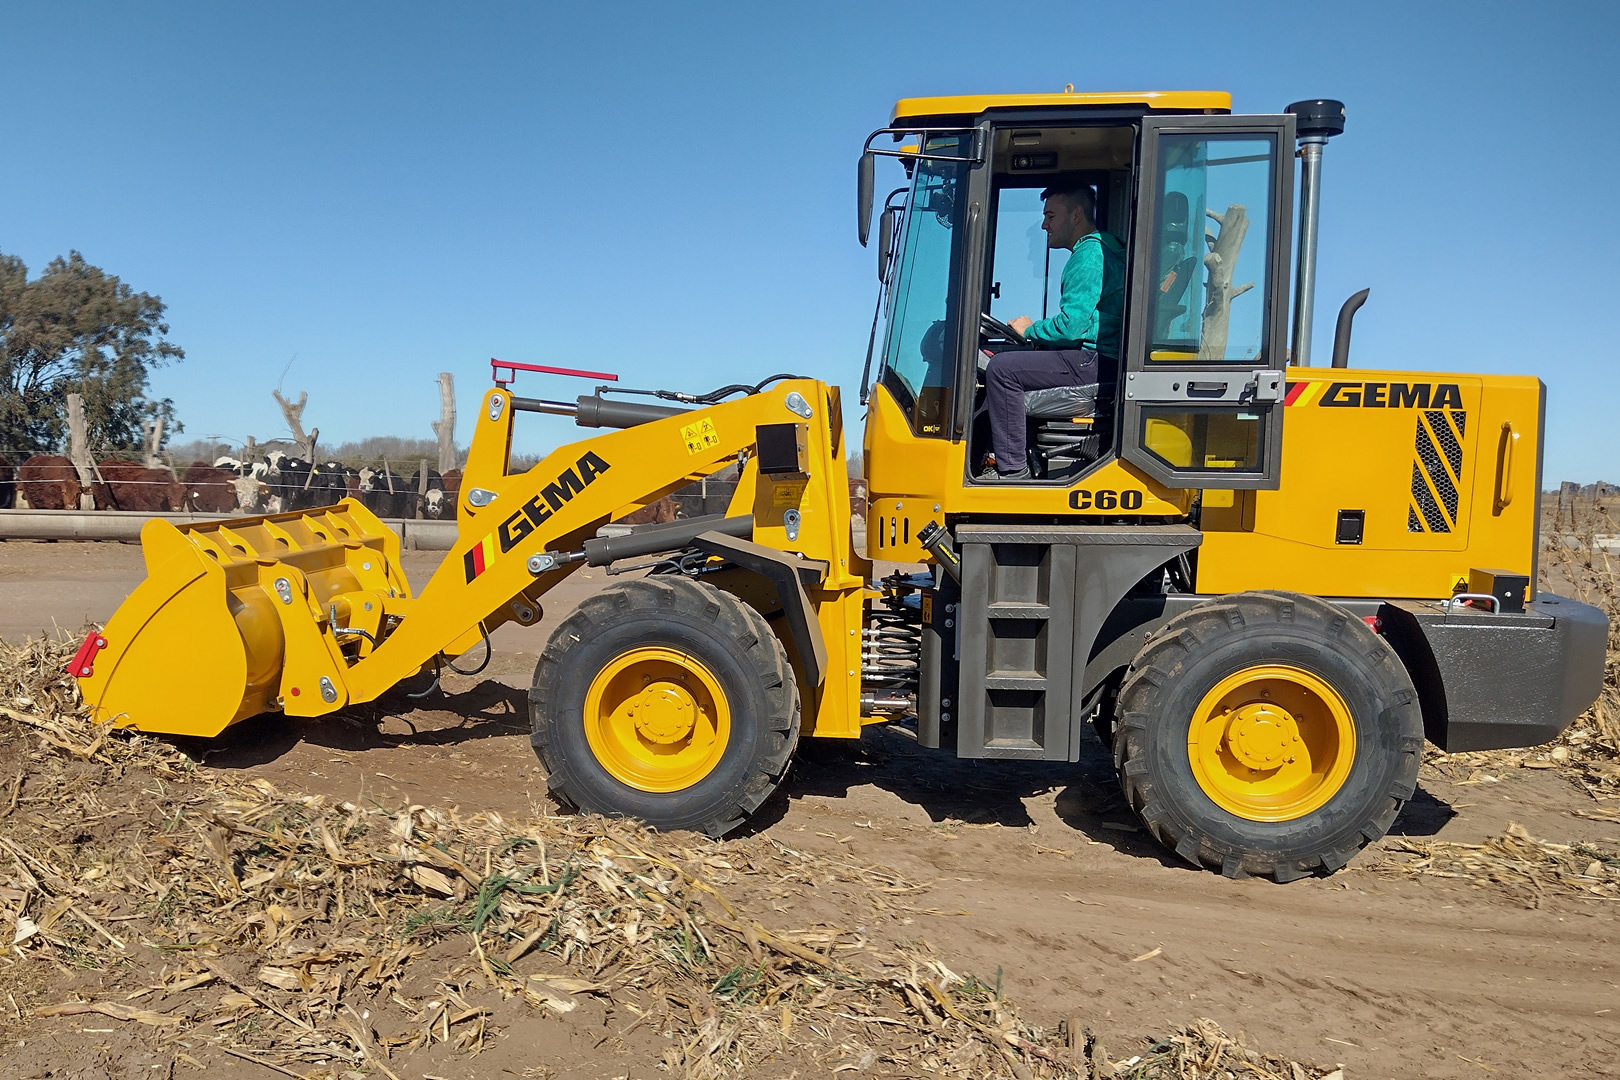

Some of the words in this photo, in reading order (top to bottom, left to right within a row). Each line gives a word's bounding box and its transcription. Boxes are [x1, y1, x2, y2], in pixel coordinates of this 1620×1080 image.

[1318, 382, 1463, 409] GEMA
[498, 450, 612, 554] GEMA
[1068, 489, 1143, 510] C60
